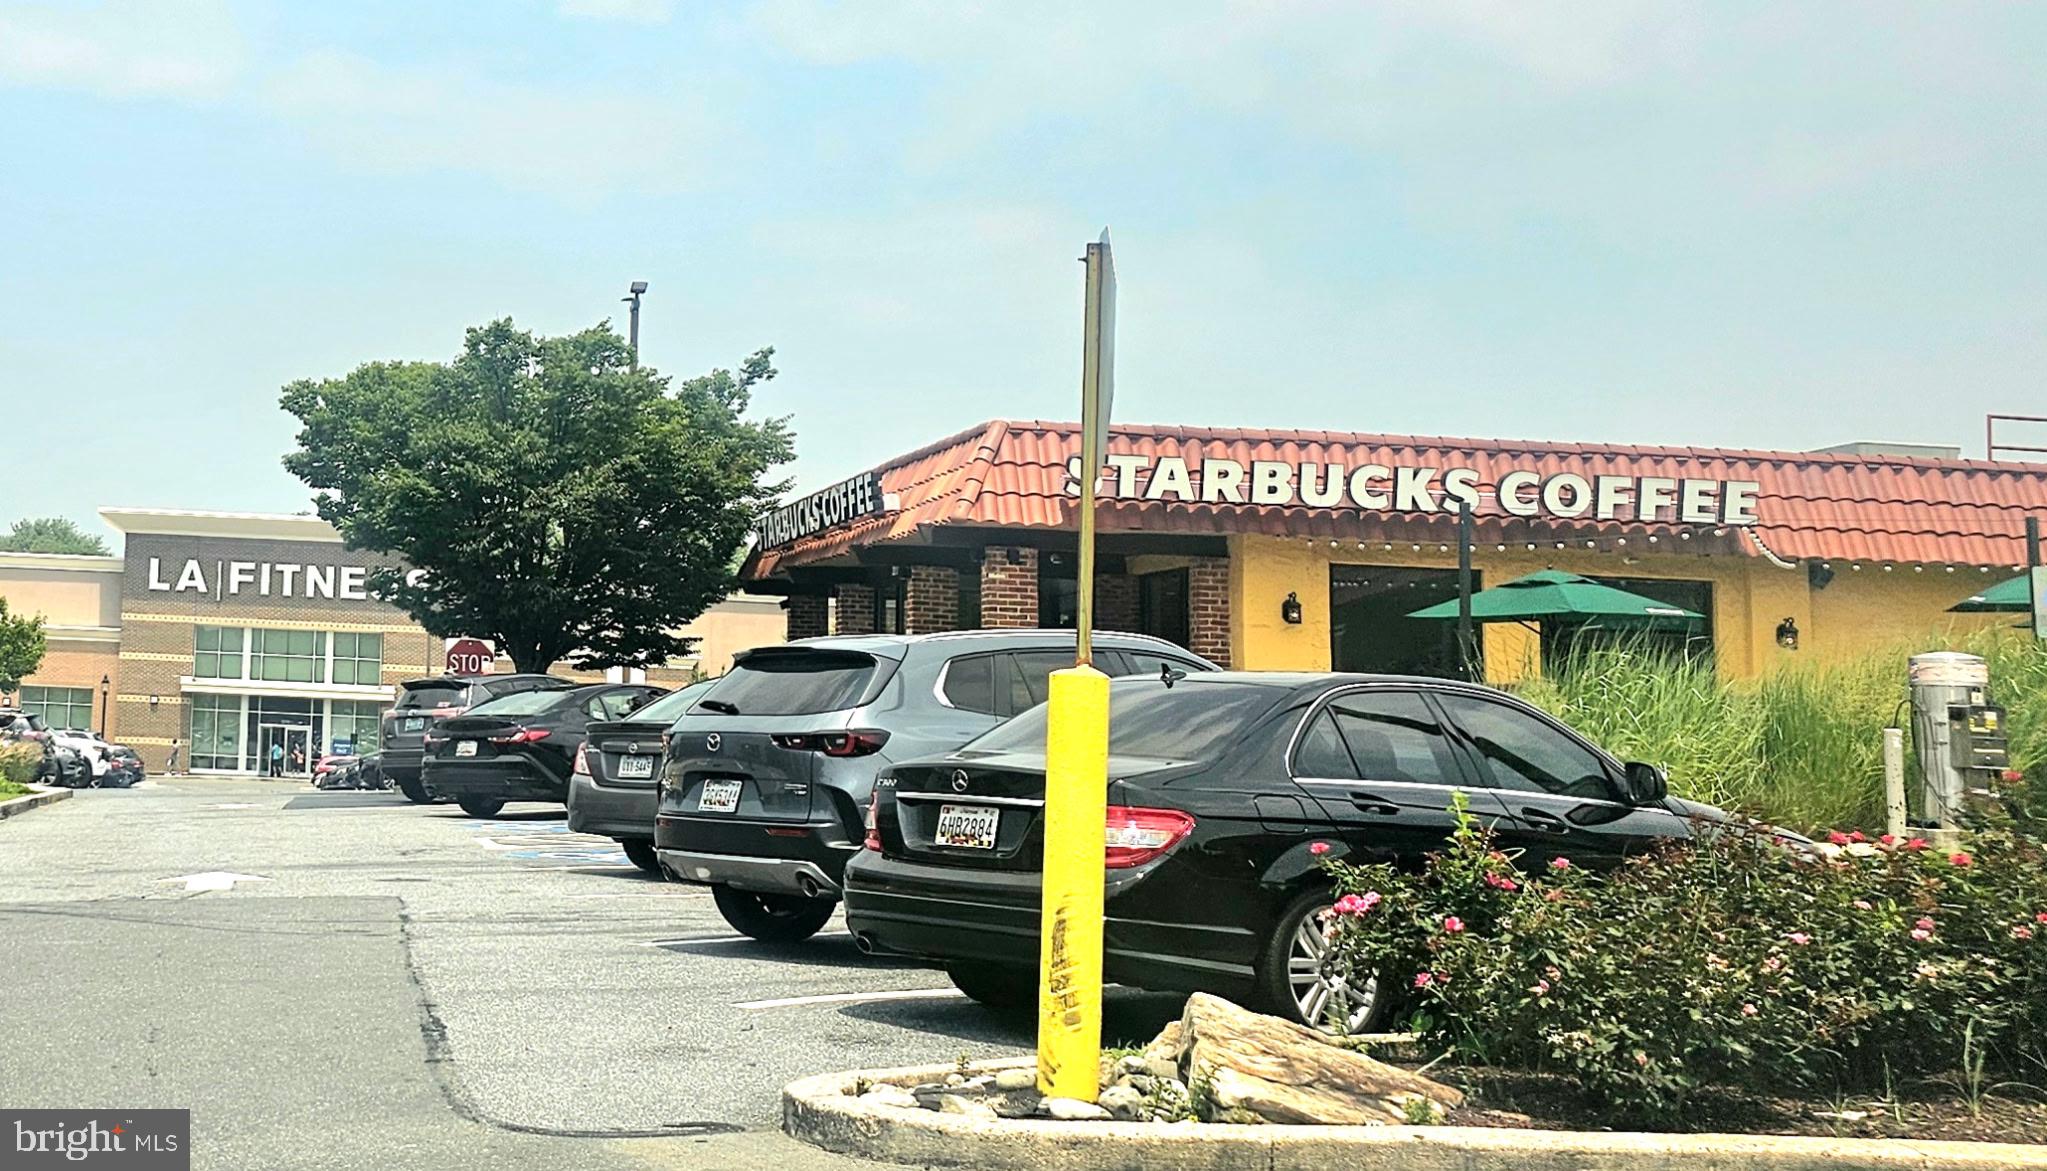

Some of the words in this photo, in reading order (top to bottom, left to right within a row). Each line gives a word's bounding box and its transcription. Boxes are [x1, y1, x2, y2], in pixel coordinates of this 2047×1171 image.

[754, 495, 821, 553] STARBUCKS
[821, 472, 874, 527] COFFEE
[1064, 454, 1481, 514] STARBUCKS
[1497, 470, 1760, 525] COFFEE
[148, 557, 208, 593] LA
[229, 560, 436, 602] FITNE
